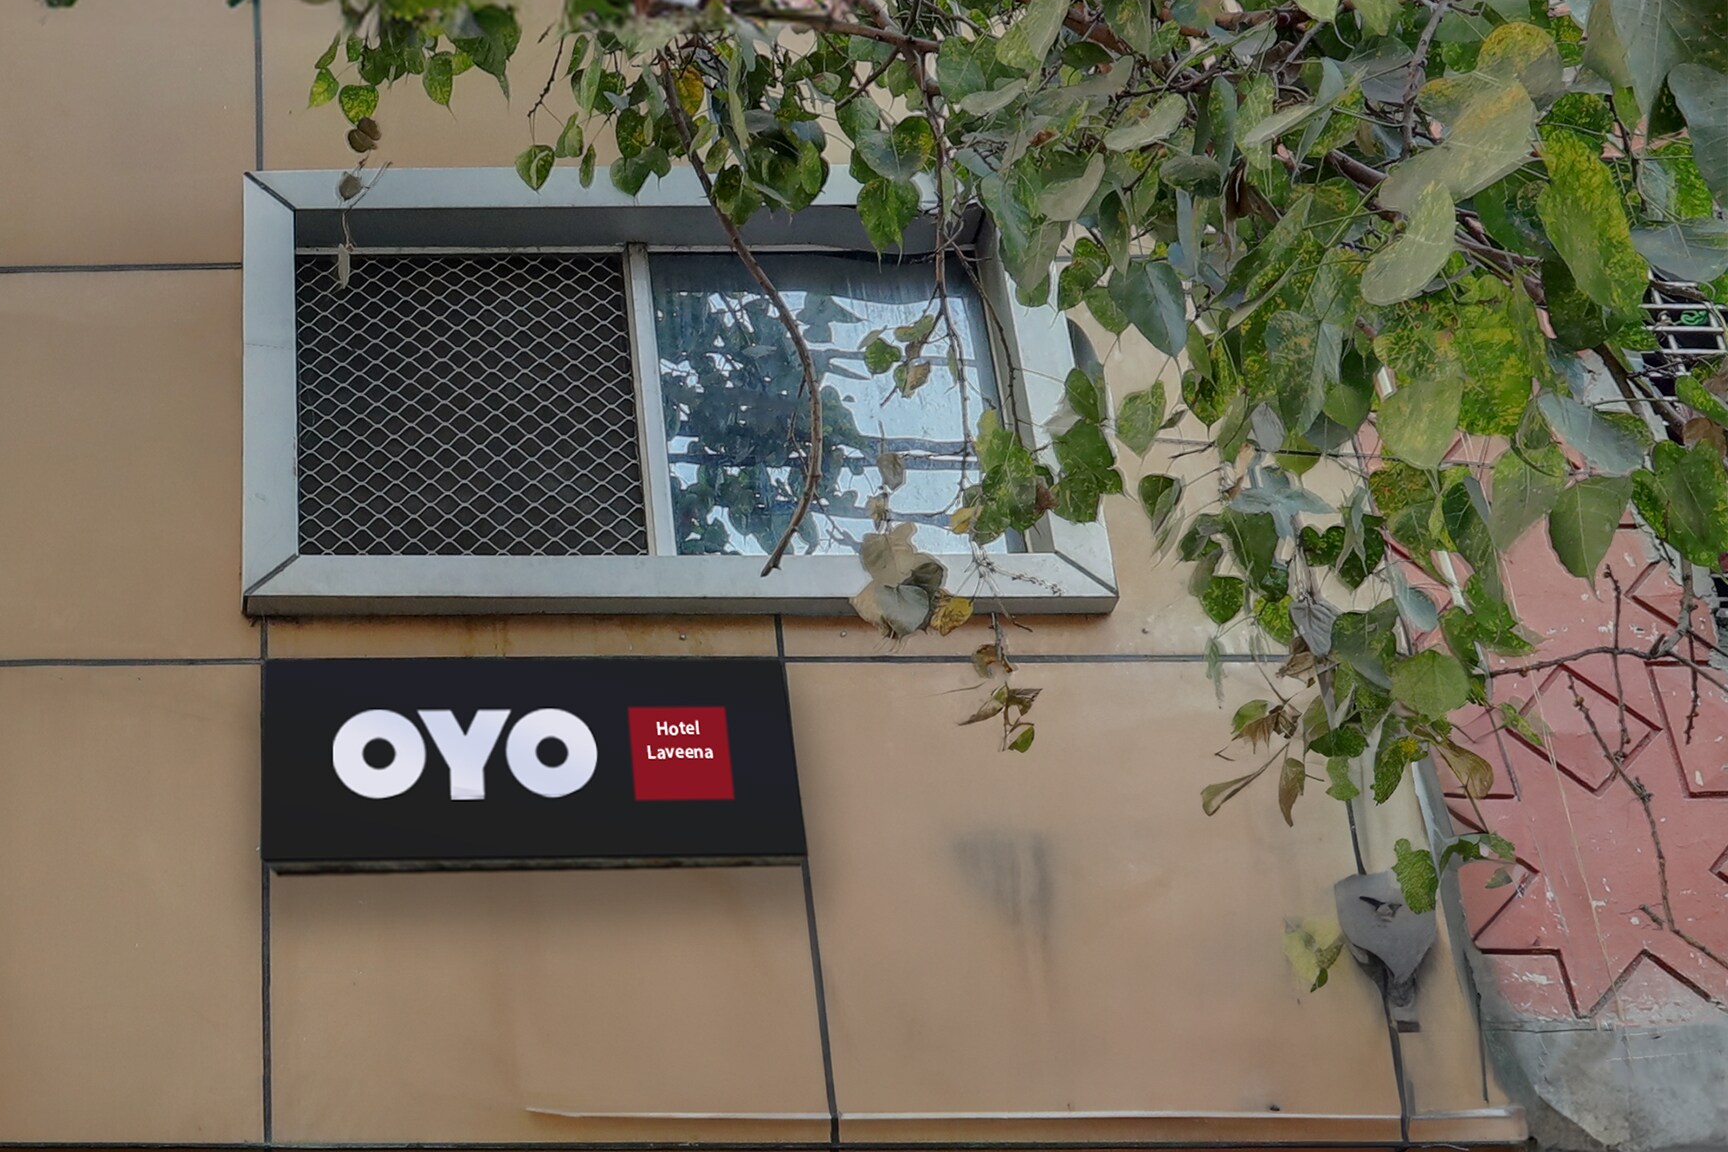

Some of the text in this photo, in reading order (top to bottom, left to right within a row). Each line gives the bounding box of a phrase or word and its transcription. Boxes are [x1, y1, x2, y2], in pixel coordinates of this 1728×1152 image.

[655, 719, 701, 737] Hotel
[332, 707, 599, 801] OYO
[646, 742, 715, 761] Laveena
